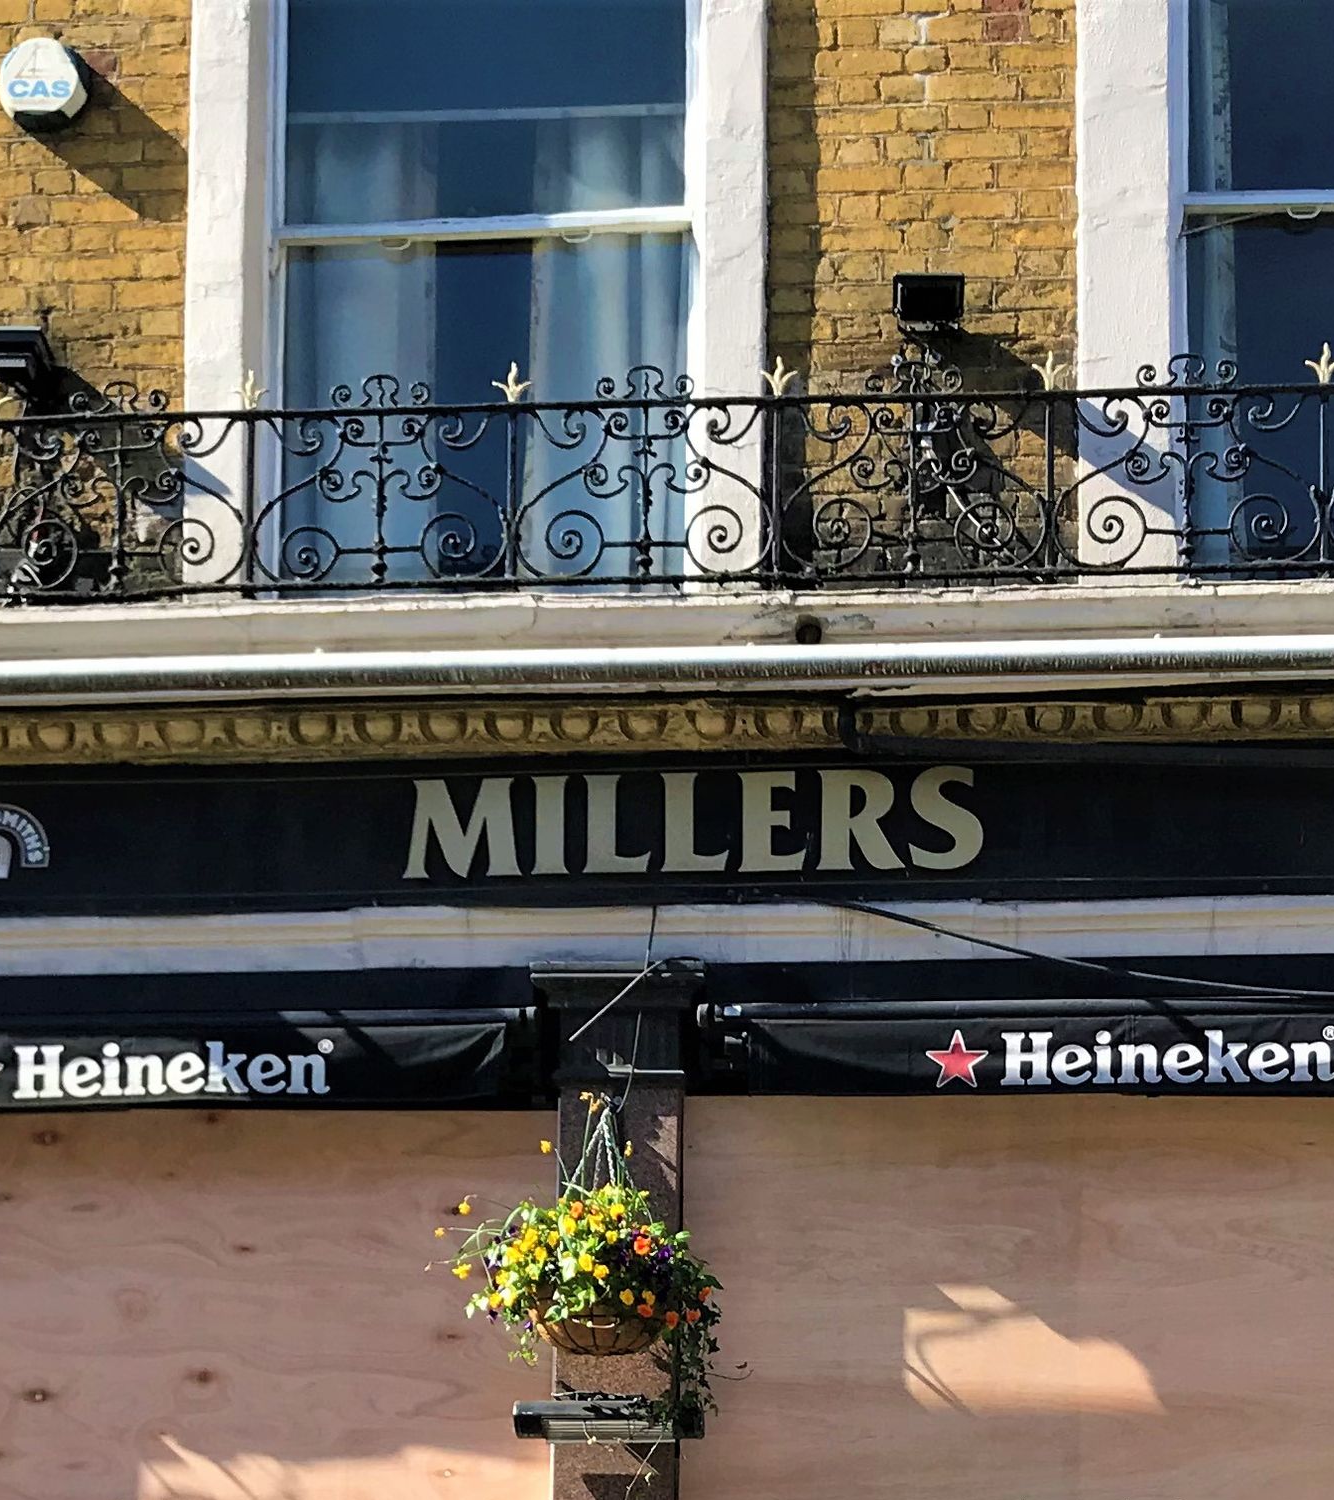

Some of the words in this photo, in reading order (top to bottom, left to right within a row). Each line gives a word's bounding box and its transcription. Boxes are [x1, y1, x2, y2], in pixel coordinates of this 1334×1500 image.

[8, 79, 71, 98] CAS
[402, 766, 985, 880] MILLERS
[12, 1040, 331, 1099] Heineken
